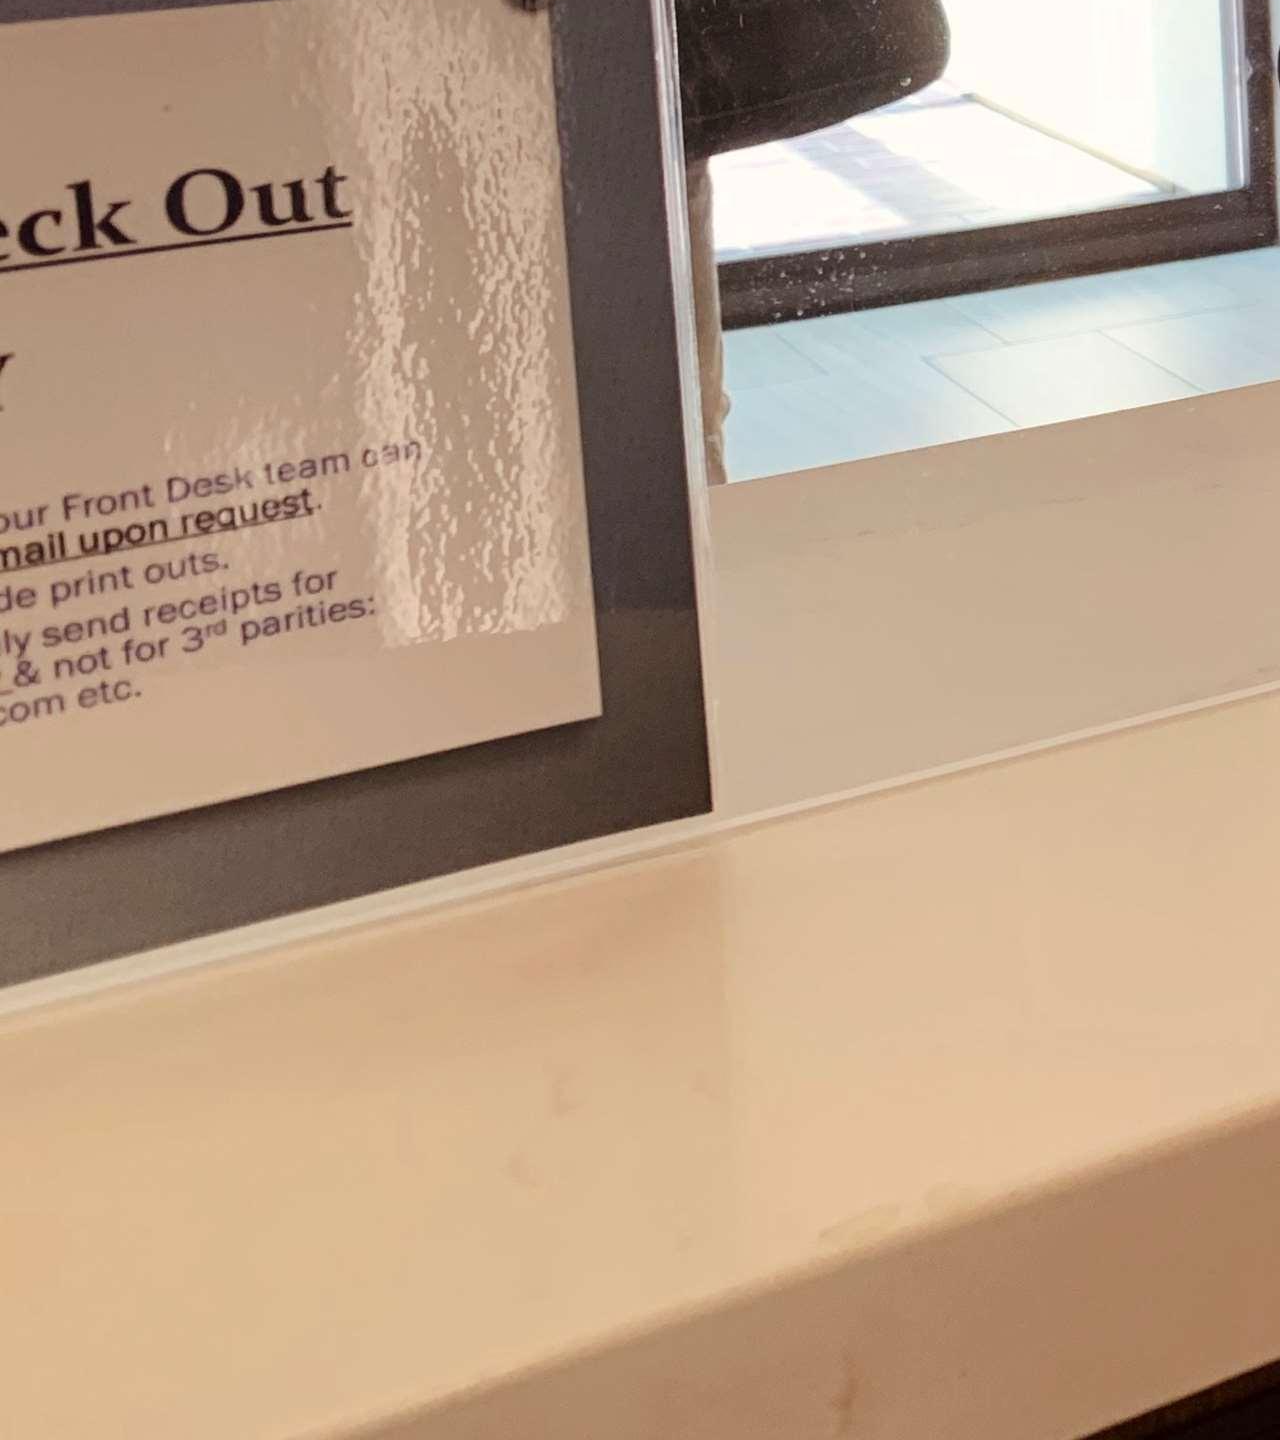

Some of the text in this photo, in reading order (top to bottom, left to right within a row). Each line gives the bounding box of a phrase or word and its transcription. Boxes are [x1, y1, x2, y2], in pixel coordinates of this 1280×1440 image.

[0, 165, 353, 259] ck Out
[62, 485, 155, 522] Front
[167, 467, 254, 503] Desk
[264, 452, 350, 485] team
[361, 441, 422, 468] can
[79, 518, 168, 555] upon
[182, 488, 322, 536] request.
[42, 607, 130, 648] send
[145, 581, 283, 627] receipts
[292, 570, 338, 597] for
[51, 565, 134, 608] print
[145, 551, 229, 585] outs.
[14, 595, 376, 687] & not for 3rd parities:
[78, 679, 142, 709] etc.
